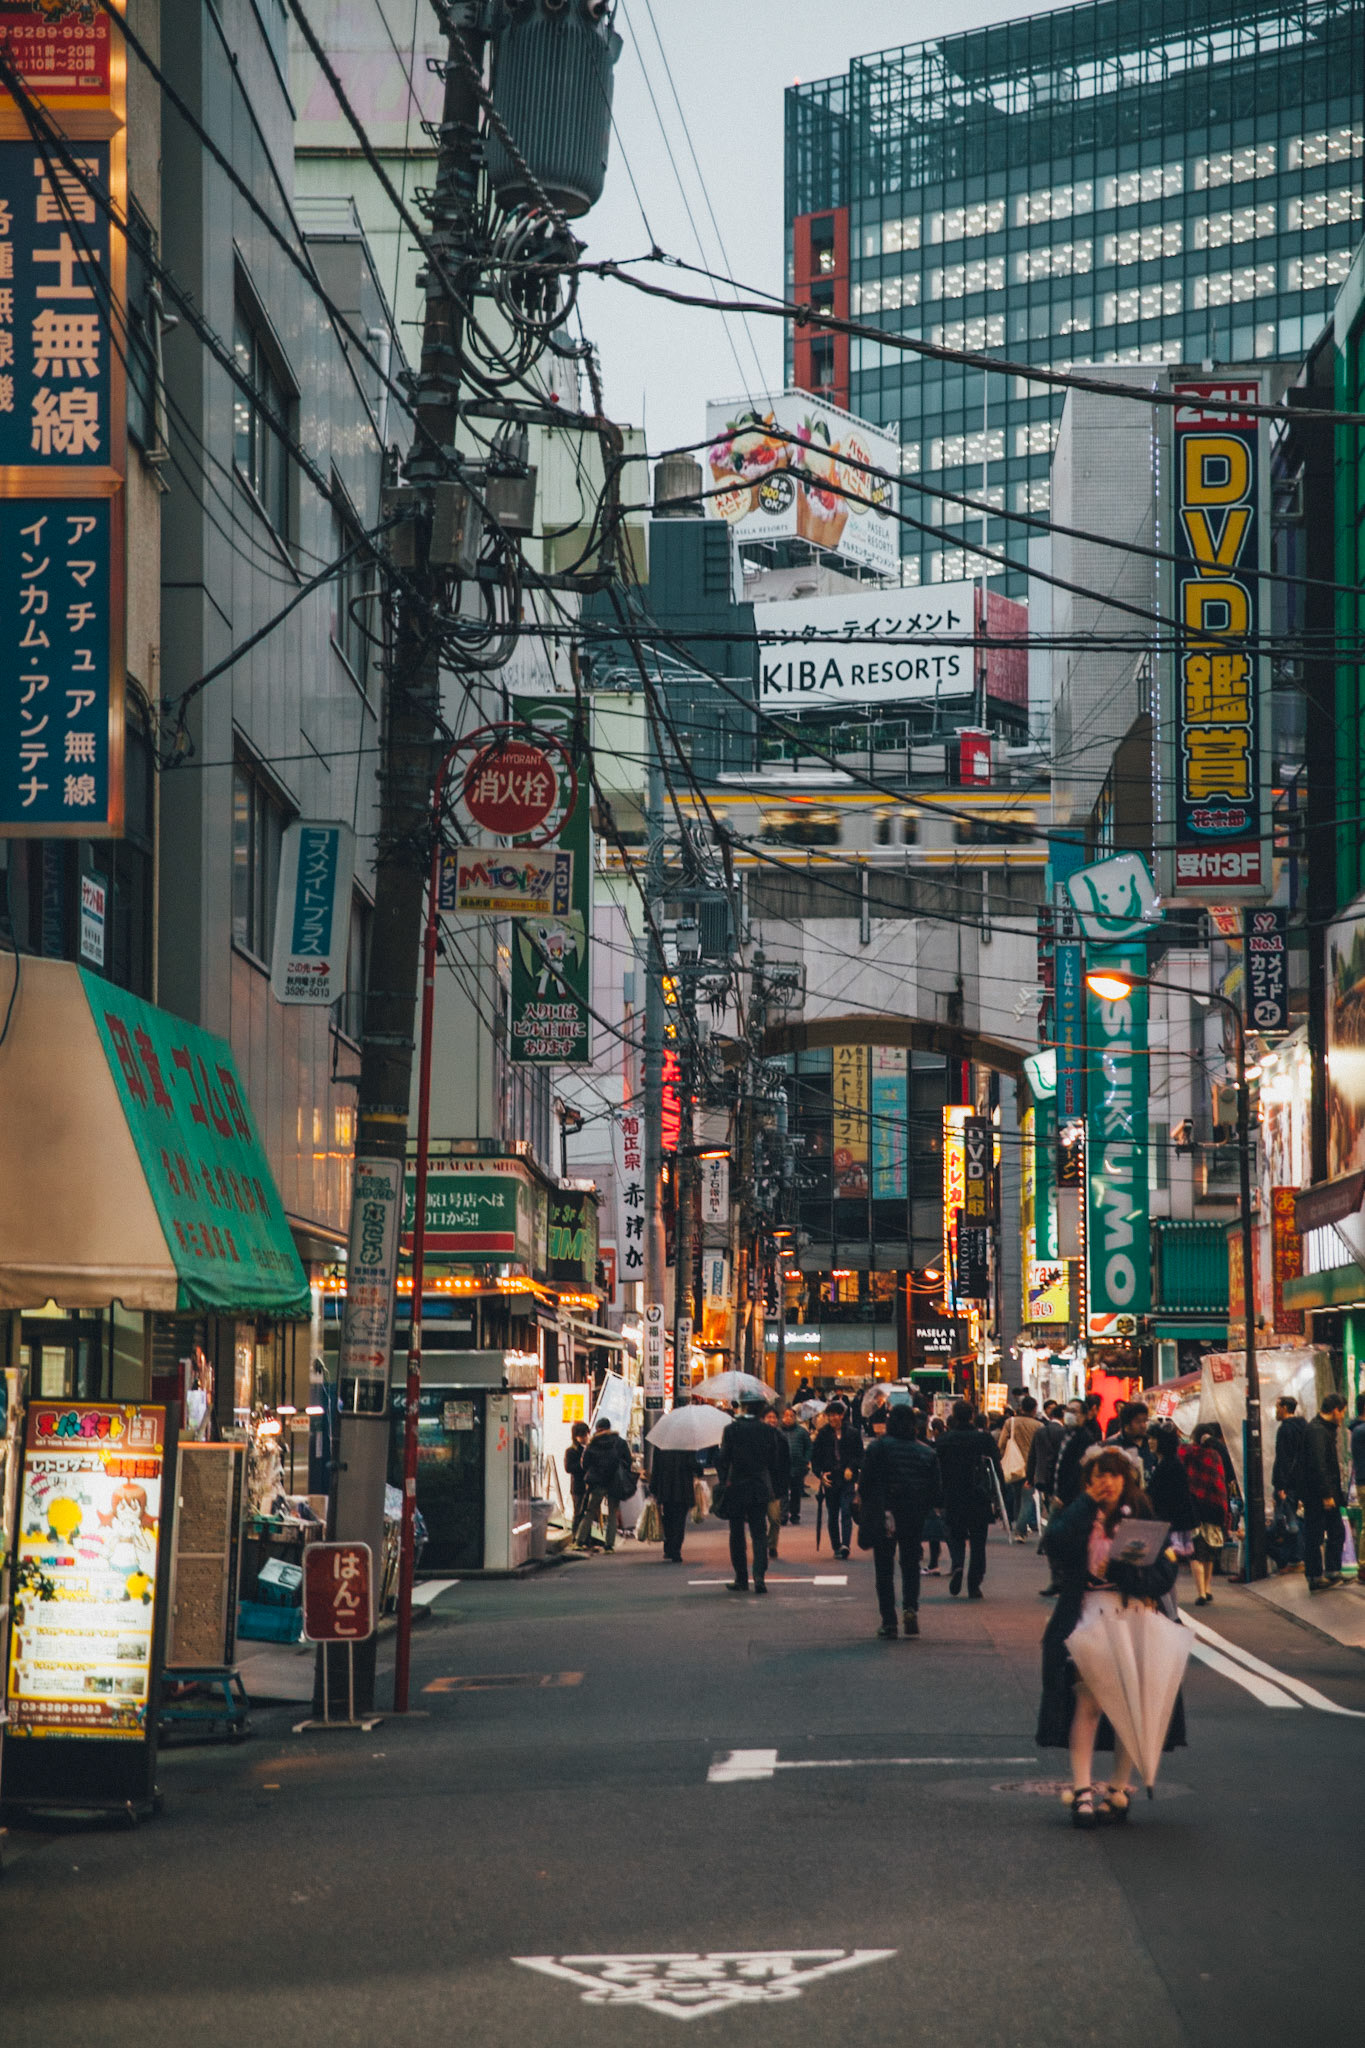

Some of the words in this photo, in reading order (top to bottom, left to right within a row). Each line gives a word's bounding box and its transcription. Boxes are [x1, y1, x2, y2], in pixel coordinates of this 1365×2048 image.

[31, 158, 101, 455] 富士無線
[19, 516, 49, 807] インカム・アンテナ
[64, 516, 97, 805] アマチュア無線
[851, 654, 960, 686] RESORTS
[502, 753, 542, 766] HYDRANT
[471, 769, 549, 807] 消火栓
[1177, 852, 1260, 878] 受付3F
[1250, 936, 1284, 951] No.1
[1250, 954, 1267, 997] カフェ
[1267, 954, 1283, 1000] メイド
[1258, 1006, 1277, 1021] 2F
[622, 1117, 642, 1172] 菊正宗
[916, 1328, 947, 1338] PASELA
[32, 1459, 105, 1473] レトロゲーム
[333, 1552, 360, 1635] はんこ
